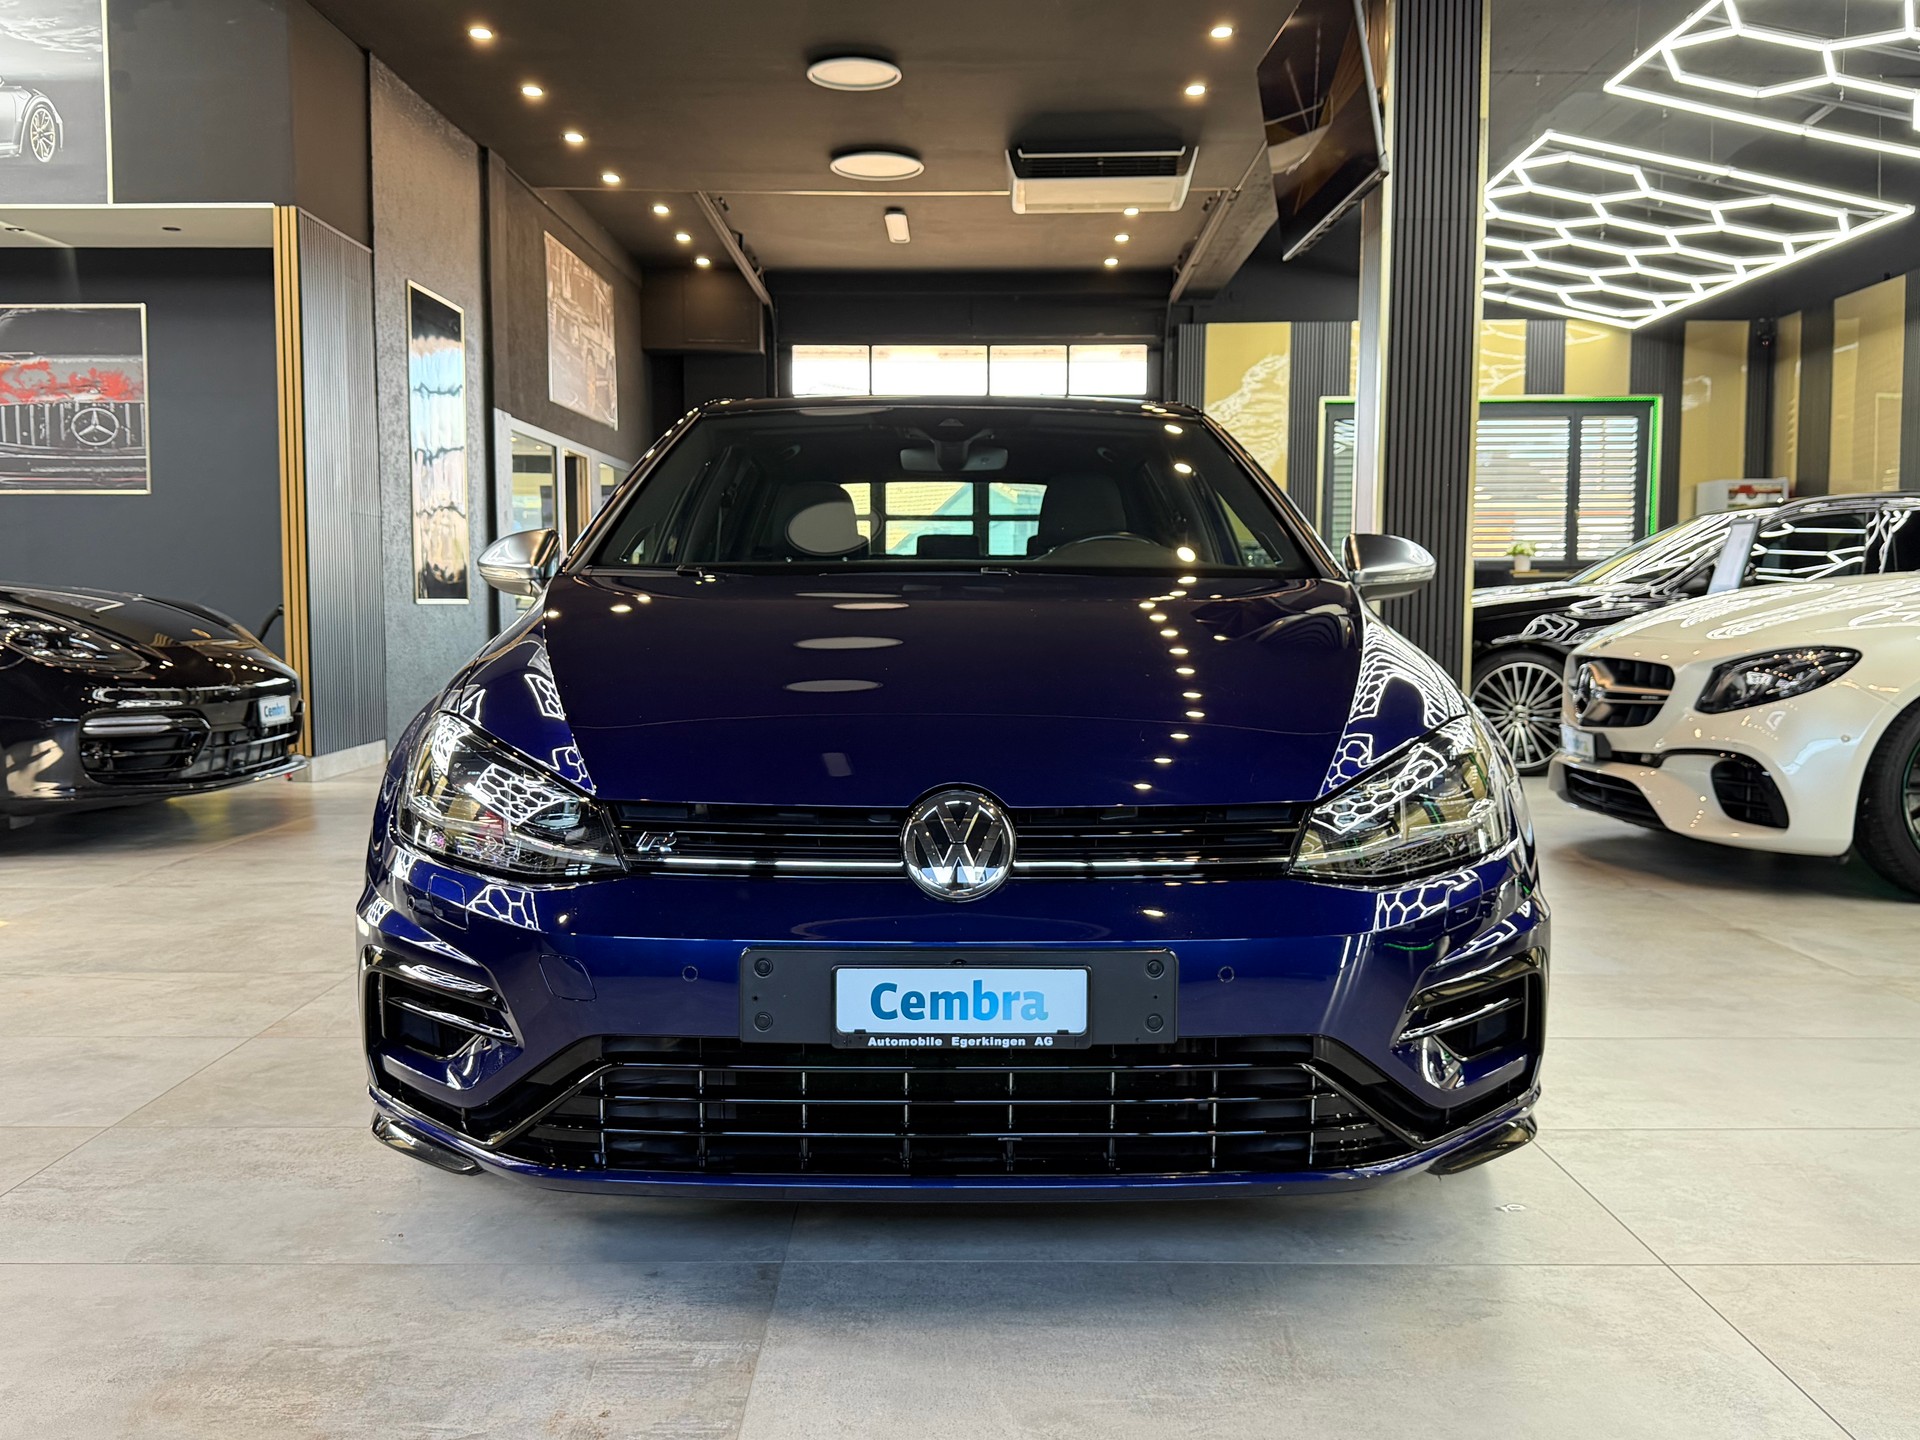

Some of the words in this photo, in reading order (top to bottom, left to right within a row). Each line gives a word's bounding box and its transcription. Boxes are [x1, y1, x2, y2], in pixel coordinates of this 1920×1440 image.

[870, 980, 1049, 1021] Cembra
[867, 1036, 943, 1047] Automobile
[951, 1036, 1026, 1049] Egerkingen
[1034, 1036, 1053, 1047] AG
